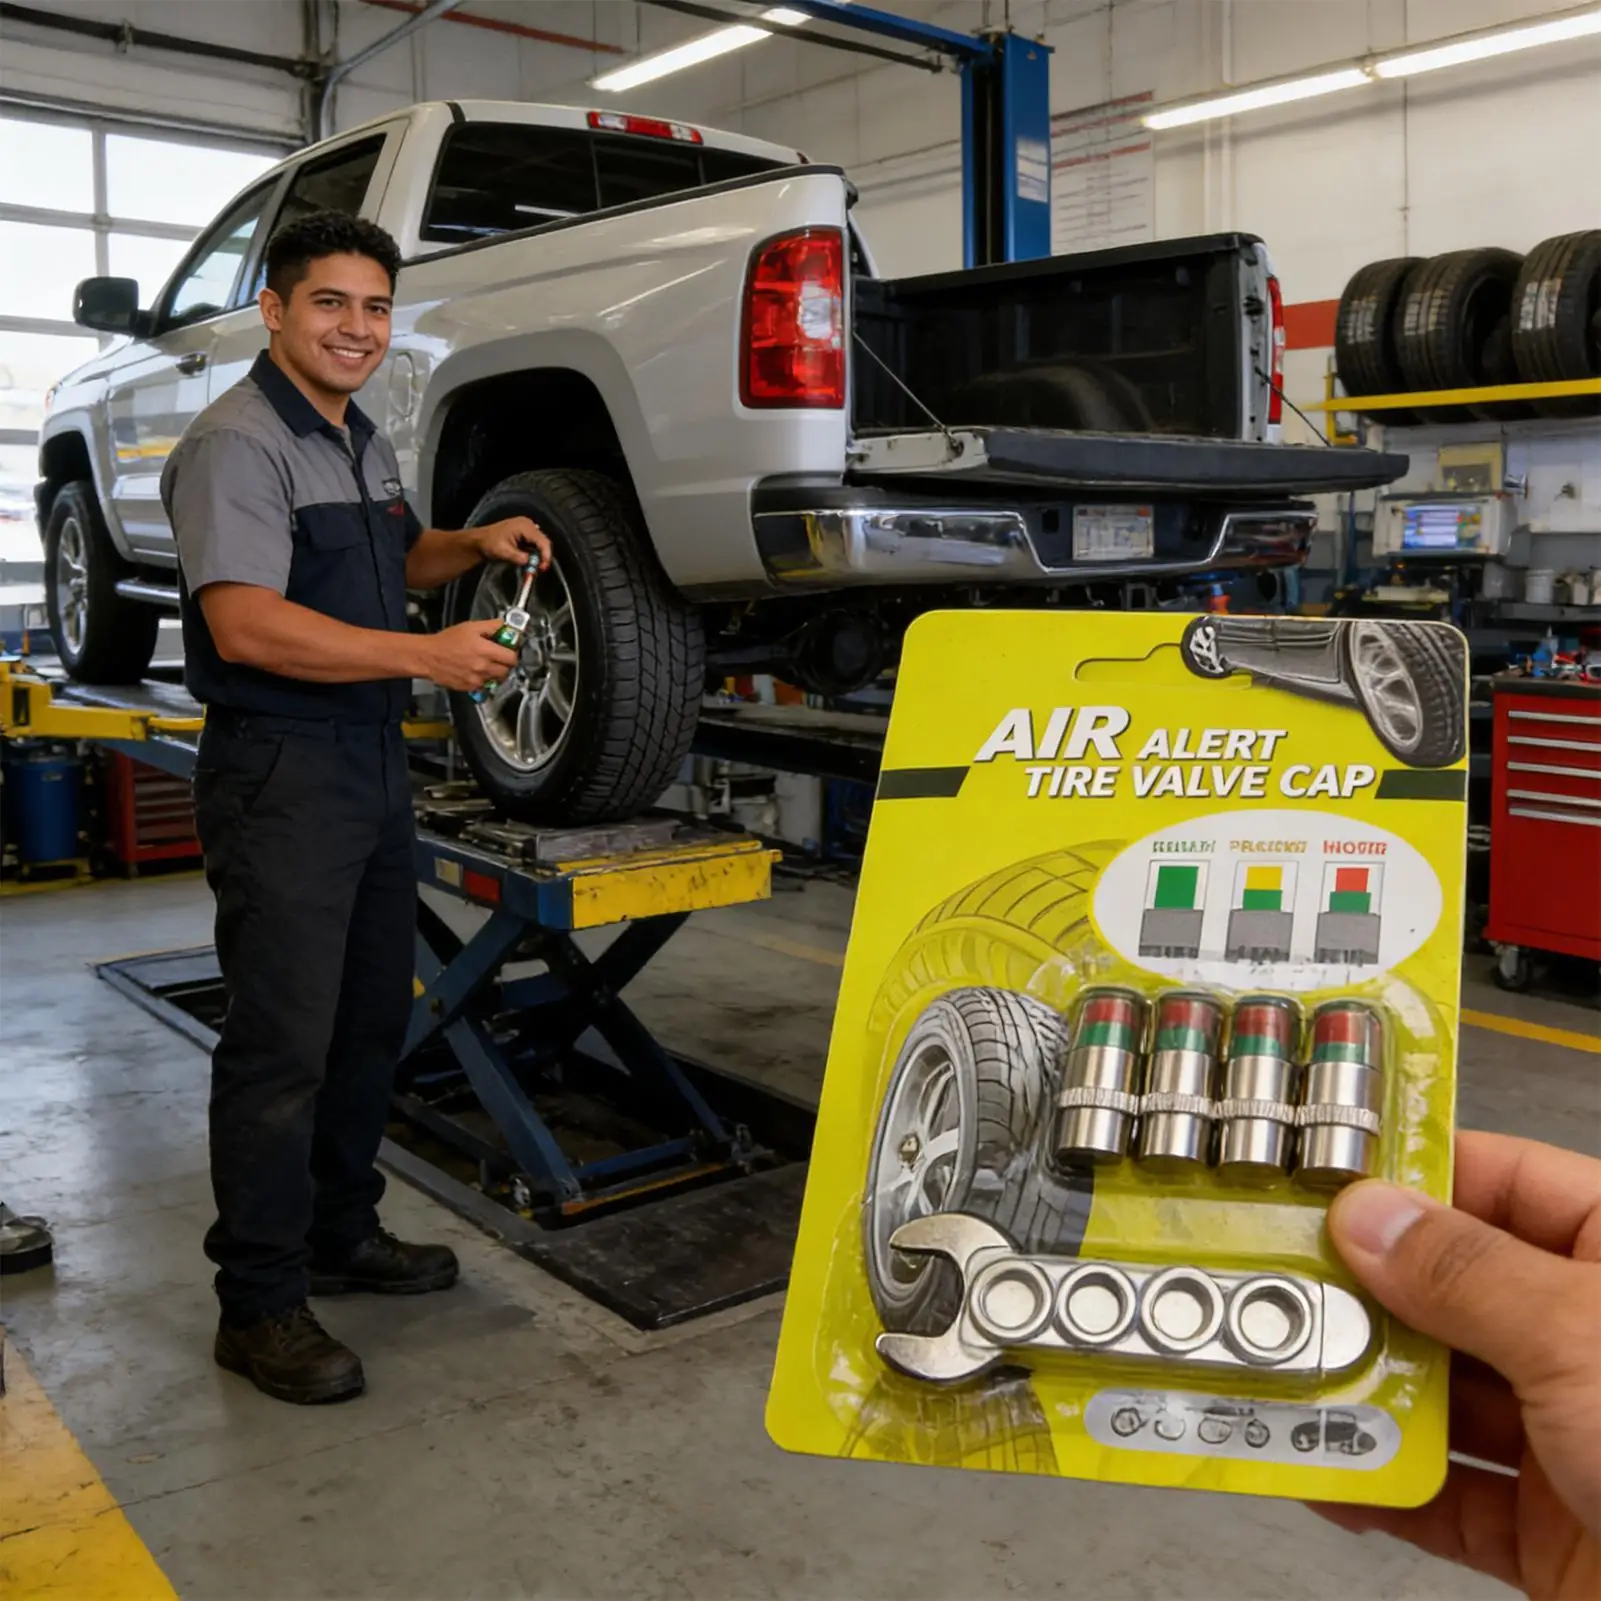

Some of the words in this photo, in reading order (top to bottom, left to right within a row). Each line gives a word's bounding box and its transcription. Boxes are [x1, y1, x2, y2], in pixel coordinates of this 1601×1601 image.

[973, 706, 1132, 762] AIR
[1136, 728, 1288, 760] ALERT
[1025, 766, 1120, 799] TIRE
[1132, 765, 1270, 799] VALVE
[1279, 764, 1376, 799] CAP
